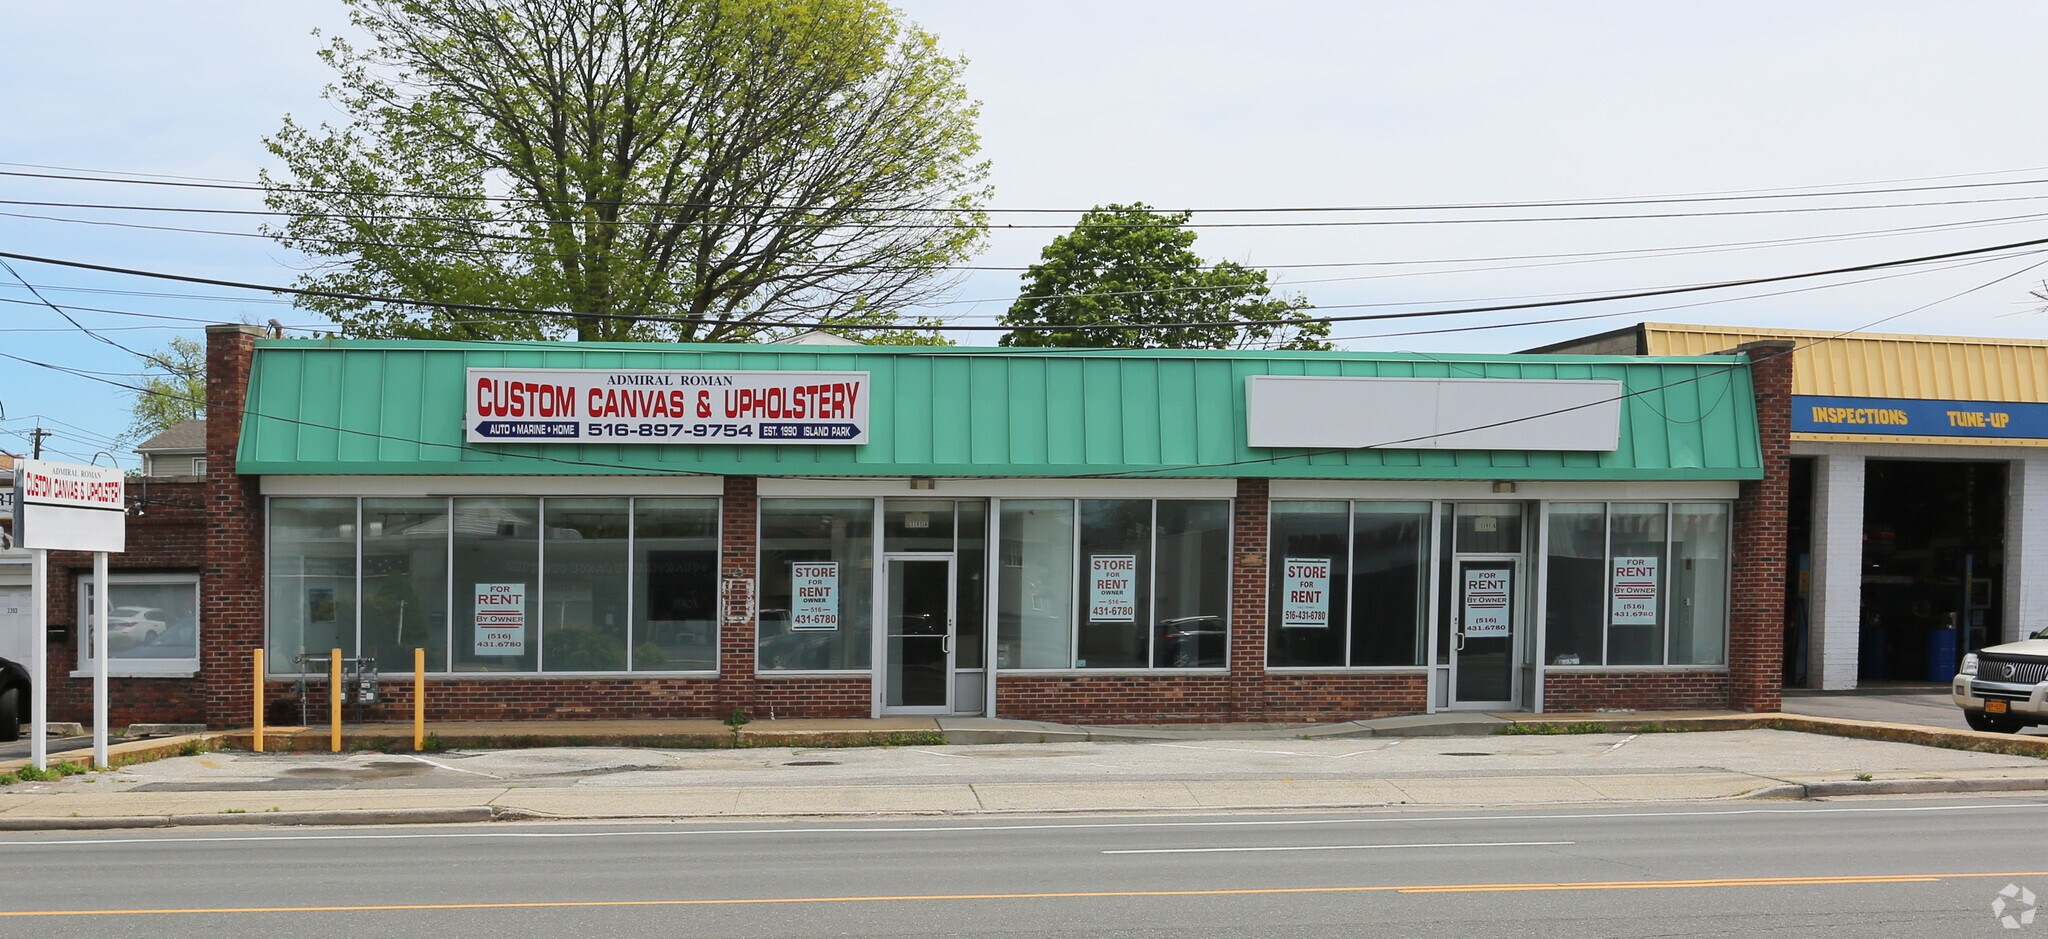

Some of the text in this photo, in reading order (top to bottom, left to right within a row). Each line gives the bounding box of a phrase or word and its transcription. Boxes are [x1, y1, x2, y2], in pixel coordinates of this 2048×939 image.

[607, 375, 733, 386] ADMIRAL ROMAN
[477, 377, 860, 419] CUSTOM CANVAS & UPHOLSTERY
[1811, 406, 2010, 428] INSPECTIONS TUNE-UP
[490, 424, 575, 435] AUTO MARINE HOME
[588, 423, 753, 437] 516-897-9754
[763, 426, 797, 437] EST. 1990
[803, 426, 852, 437] ISLAND PARK
[52, 467, 102, 479] ADMIRAL ROMAN
[26, 472, 53, 498] CUSTOM
[54, 478, 78, 500] CANVAS
[86, 481, 122, 503] UPHOLSTERY
[1093, 560, 1133, 570] STORE
[795, 567, 836, 578] STORE
[1288, 565, 1327, 579] STORE
[1616, 567, 1656, 577] RENT
[490, 585, 511, 593] FOR
[1097, 579, 1128, 589] RENT
[1468, 580, 1506, 590] RENT
[799, 587, 831, 597] RENT
[1291, 590, 1322, 603] RENT
[478, 594, 522, 605] RENT
[476, 615, 524, 623] BY OWNER
